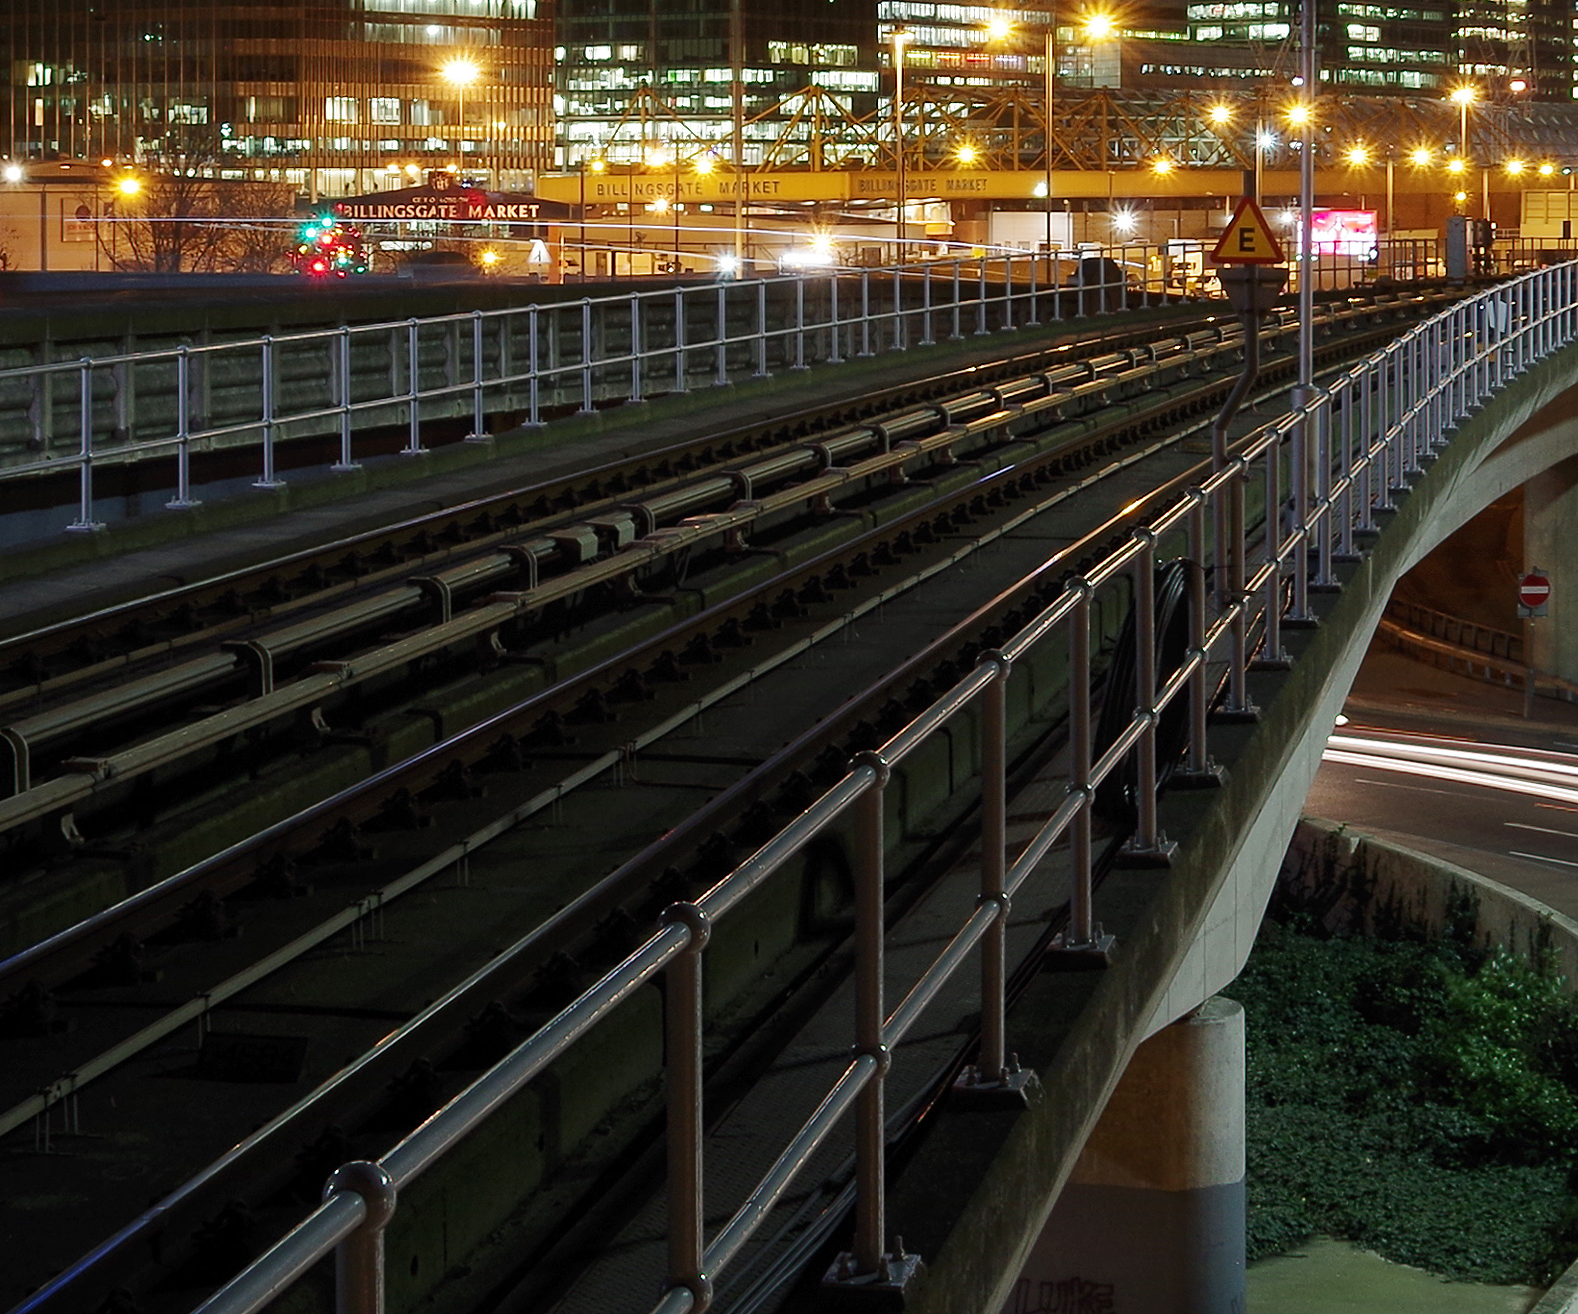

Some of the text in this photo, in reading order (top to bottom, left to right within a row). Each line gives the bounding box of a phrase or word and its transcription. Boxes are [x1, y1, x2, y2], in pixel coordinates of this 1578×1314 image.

[596, 181, 704, 196] BILLNGSGATE
[858, 178, 989, 193] BILLINSGATE MARKET
[342, 203, 541, 219] BILLINGSGATE MARKET
[1238, 227, 1256, 252] E
